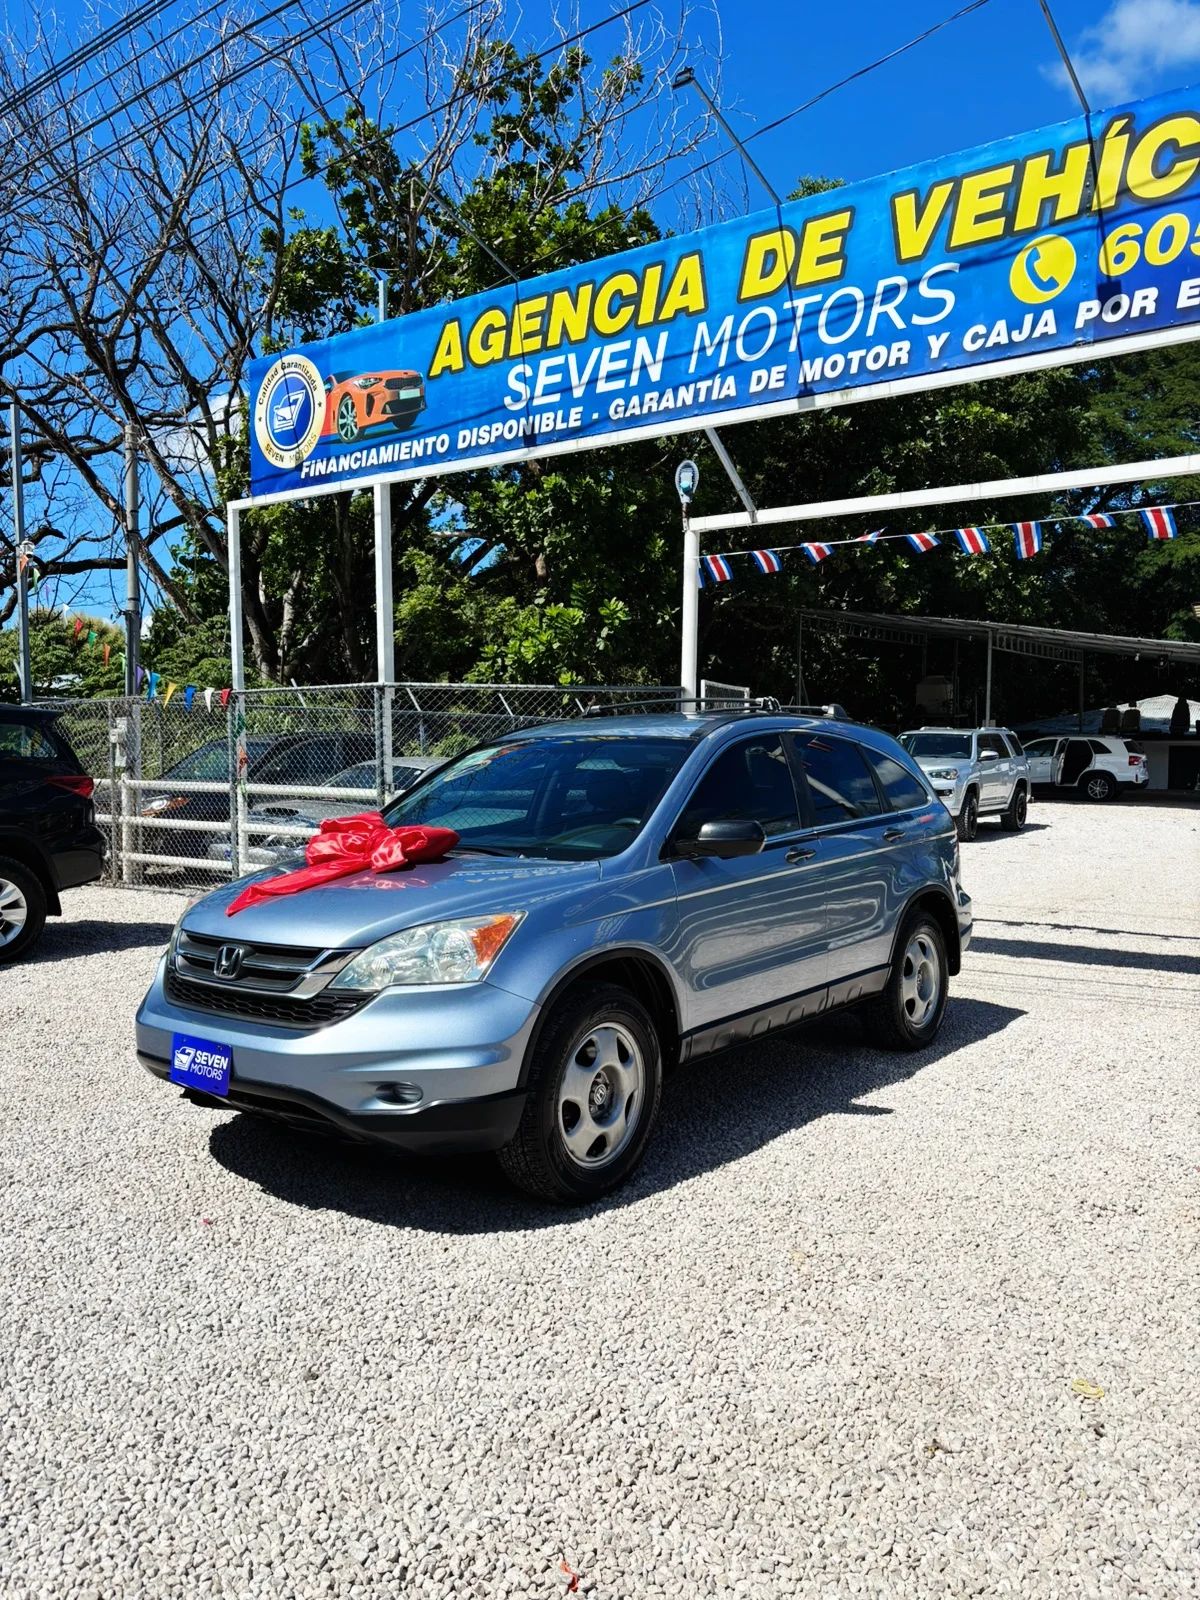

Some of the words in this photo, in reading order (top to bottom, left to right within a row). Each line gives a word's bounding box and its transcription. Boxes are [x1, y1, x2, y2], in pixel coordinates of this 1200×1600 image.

[428, 255, 706, 377] AGENCIA
[739, 211, 850, 300] DE
[1098, 211, 1200, 277] 60
[300, 433, 450, 479] FINANCIAMIENTO
[457, 405, 584, 450] DISPONIBLE
[608, 374, 737, 420] GARANTÍA
[749, 364, 787, 394] DE
[798, 340, 911, 384] MOTOR
[927, 332, 950, 359] Y
[962, 308, 1057, 352] CAJA
[1074, 286, 1159, 329] POR
[503, 330, 669, 411] SEVEN
[687, 261, 960, 374] MOTORS
[189, 1063, 224, 1081] MOTORS
[194, 1050, 229, 1070] SEVEN
